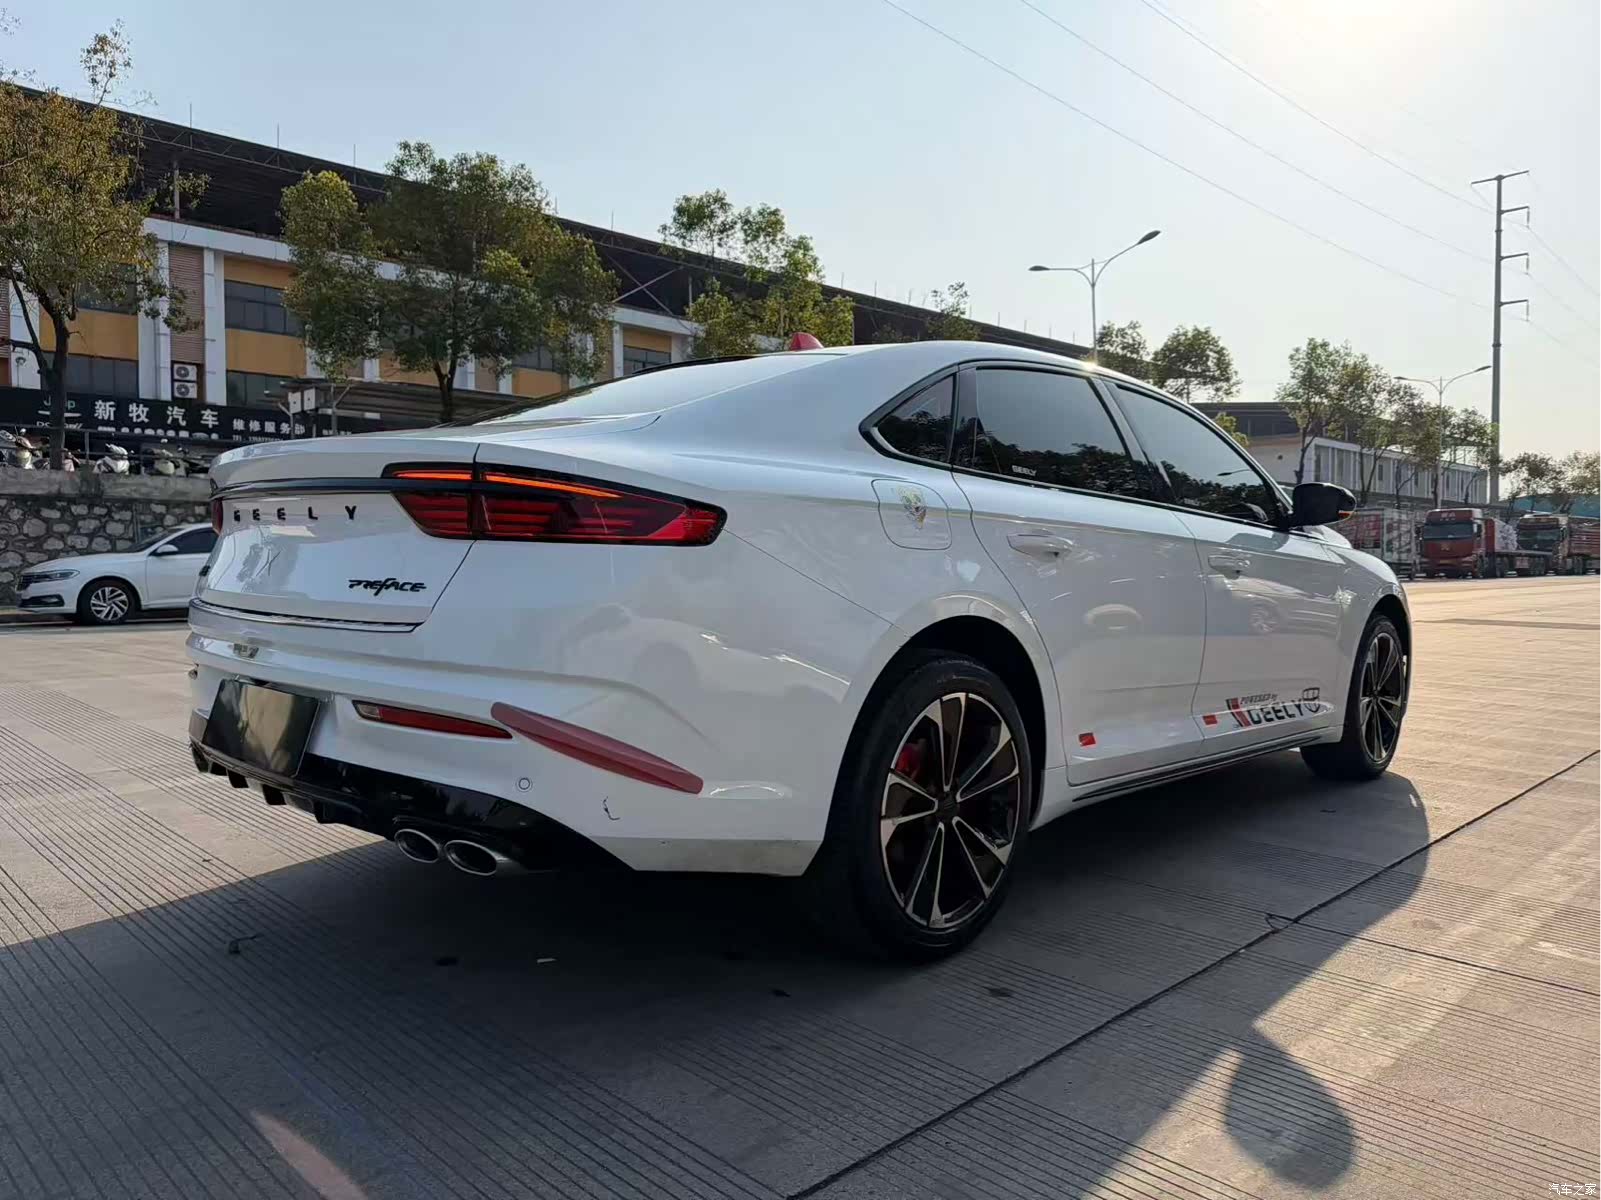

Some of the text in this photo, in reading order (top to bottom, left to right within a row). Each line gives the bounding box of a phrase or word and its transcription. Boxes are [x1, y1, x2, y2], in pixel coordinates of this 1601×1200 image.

[94, 400, 219, 429] 新牧汽车
[233, 505, 357, 522] GEELY
